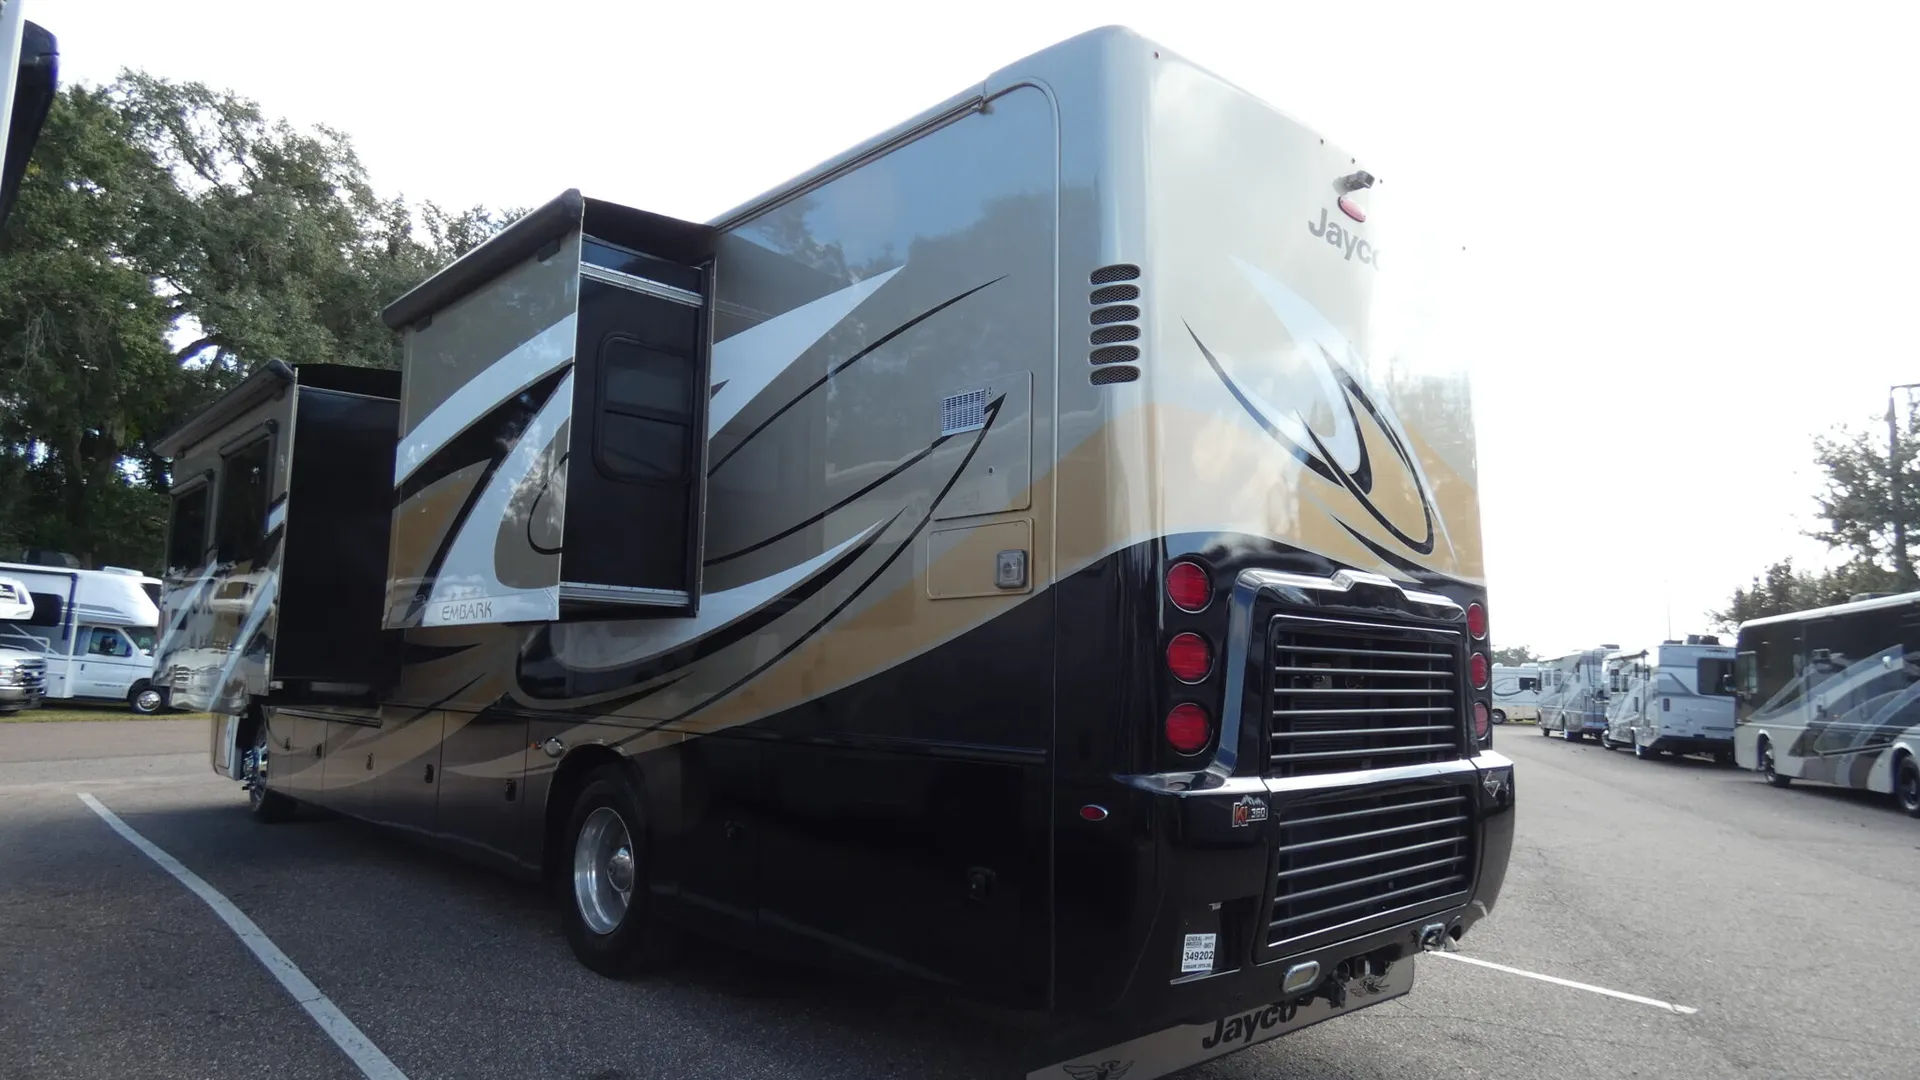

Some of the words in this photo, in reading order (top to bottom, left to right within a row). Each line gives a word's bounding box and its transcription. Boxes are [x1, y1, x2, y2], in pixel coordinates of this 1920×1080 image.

[441, 601, 492, 621] EMBARK
[1184, 950, 1214, 962] 349202
[1202, 1001, 1298, 1049] Jayco
